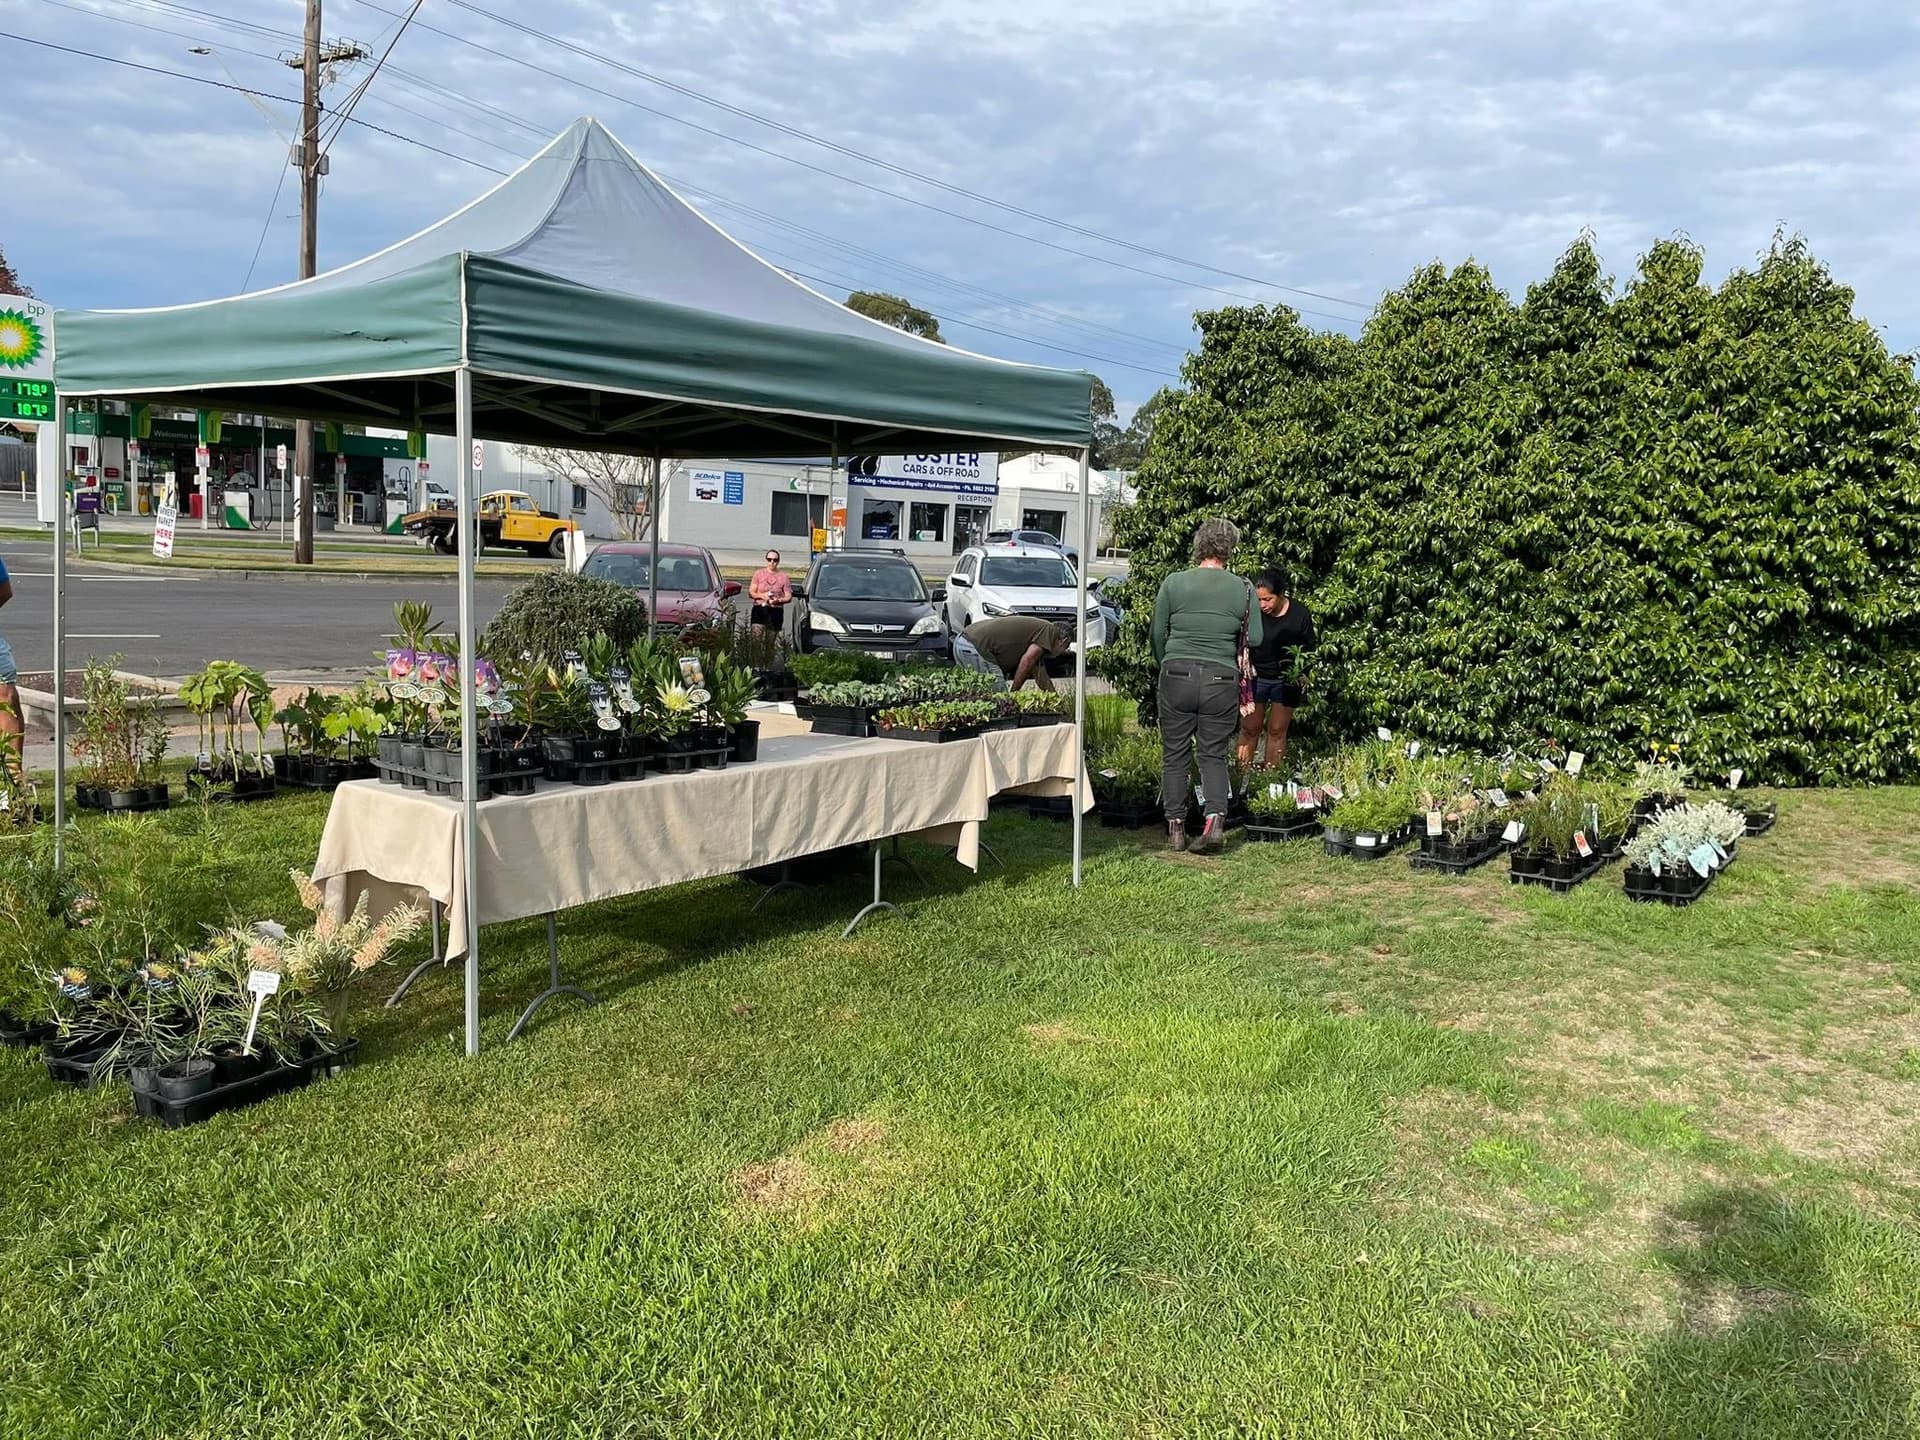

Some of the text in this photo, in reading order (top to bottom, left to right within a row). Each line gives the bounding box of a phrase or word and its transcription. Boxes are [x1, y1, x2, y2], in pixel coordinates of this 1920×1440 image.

[27, 302, 45, 317] bp
[903, 463, 980, 479] CARS & OFF ROAD
[957, 494, 993, 503] RECEPTION
[156, 528, 173, 540] HERE
